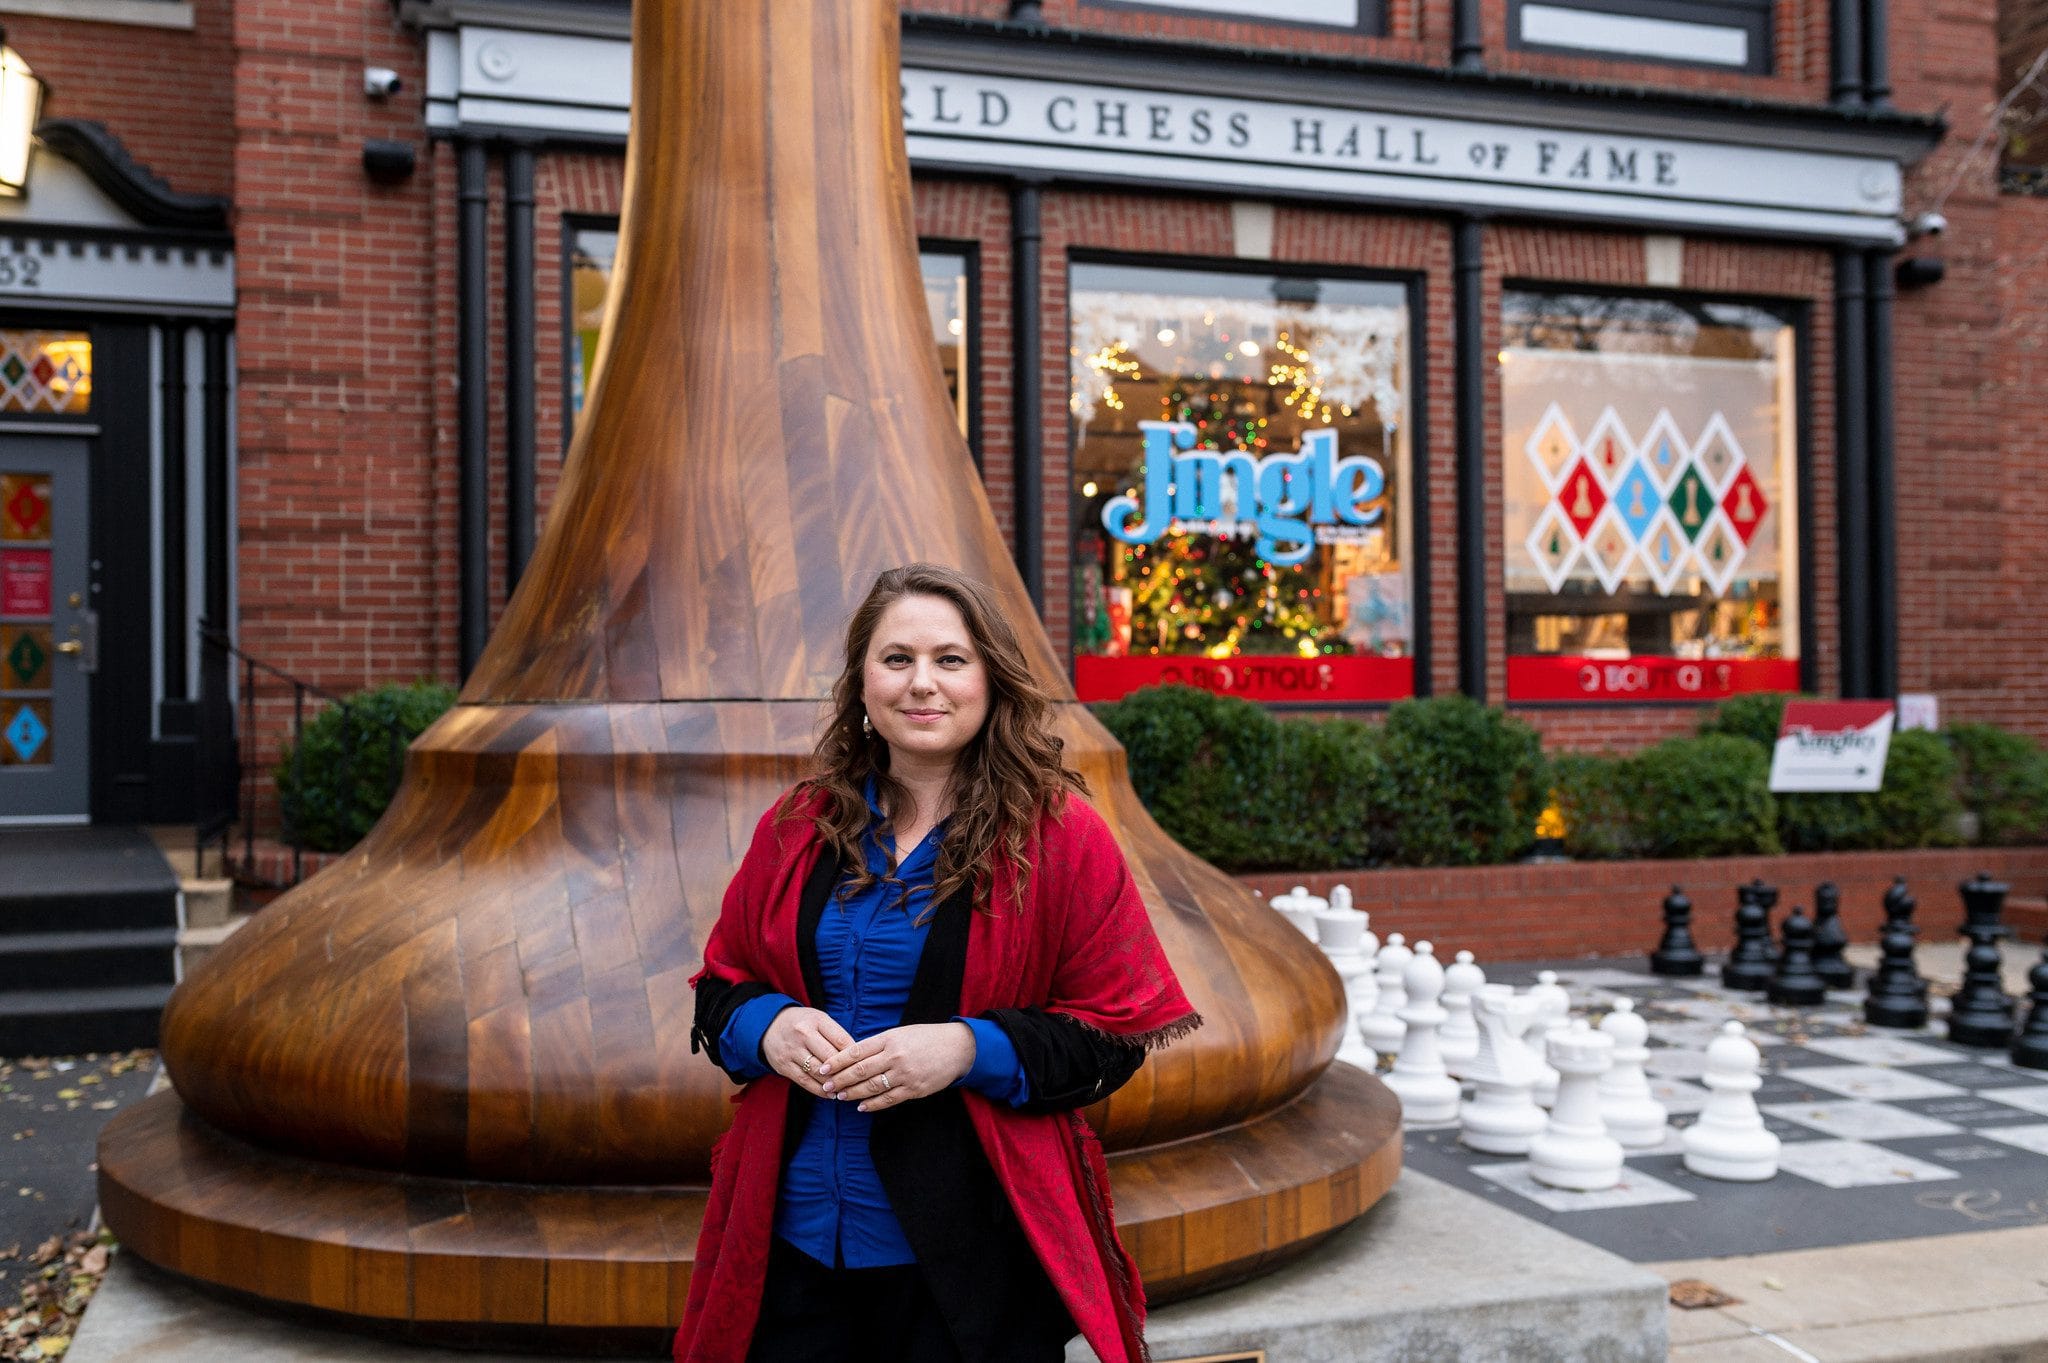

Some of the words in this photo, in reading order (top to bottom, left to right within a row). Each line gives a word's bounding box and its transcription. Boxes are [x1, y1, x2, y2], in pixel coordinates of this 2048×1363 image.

[1046, 96, 1250, 148] CHESS
[1291, 118, 1439, 166] HALL
[1537, 142, 1678, 186] FAME
[1101, 419, 1385, 567] Jingle
